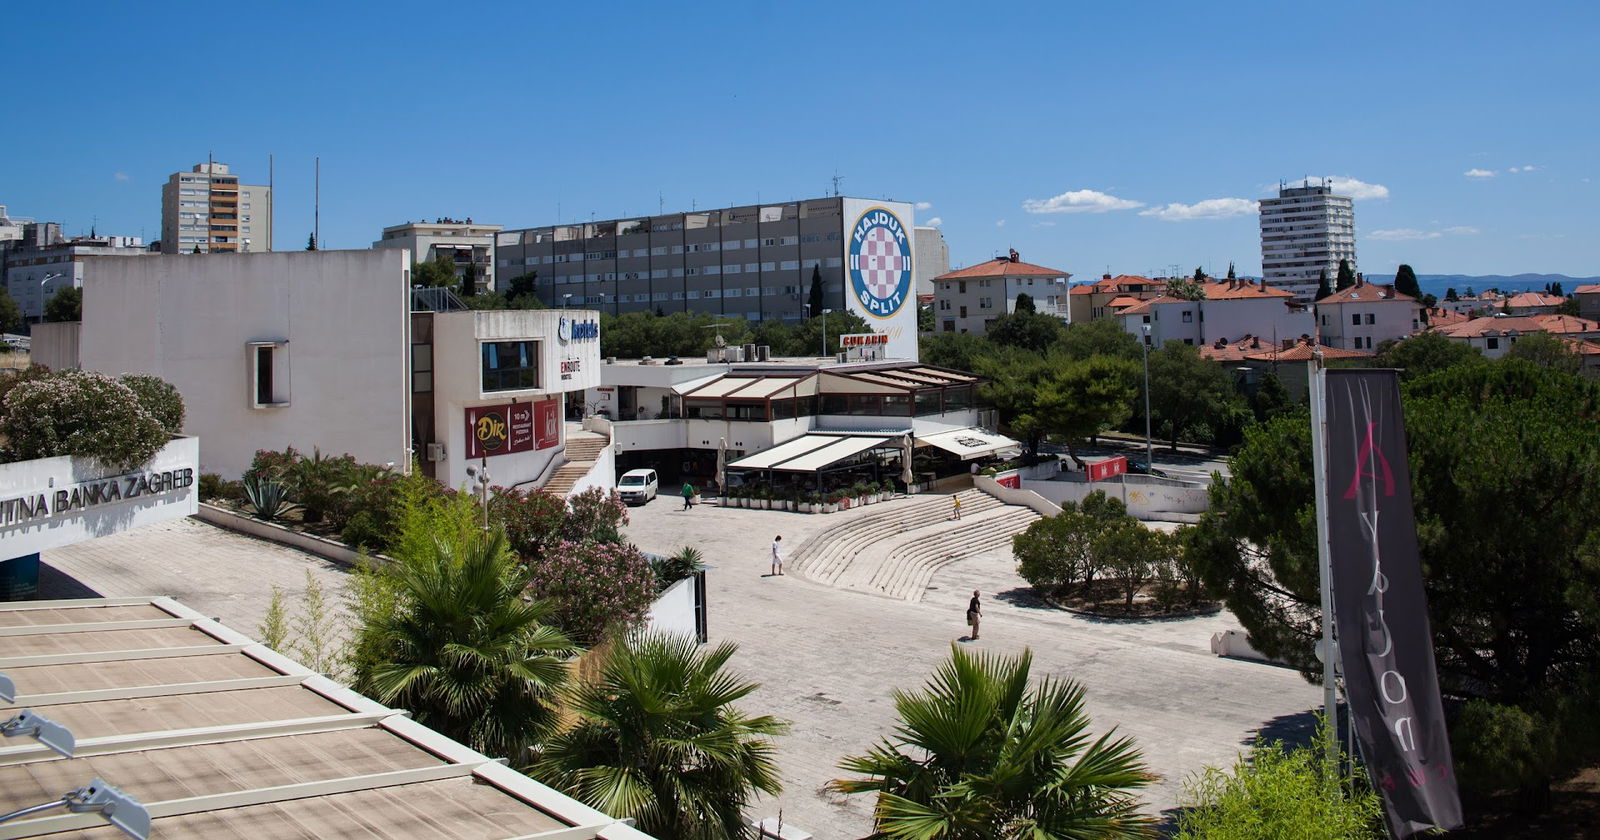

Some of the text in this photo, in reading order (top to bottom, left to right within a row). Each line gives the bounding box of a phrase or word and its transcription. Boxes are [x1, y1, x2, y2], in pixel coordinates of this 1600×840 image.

[854, 212, 906, 245] HAJDUK
[860, 290, 901, 314] SPLIT
[53, 479, 122, 513] BANKA
[124, 468, 194, 497] ZAGREB
